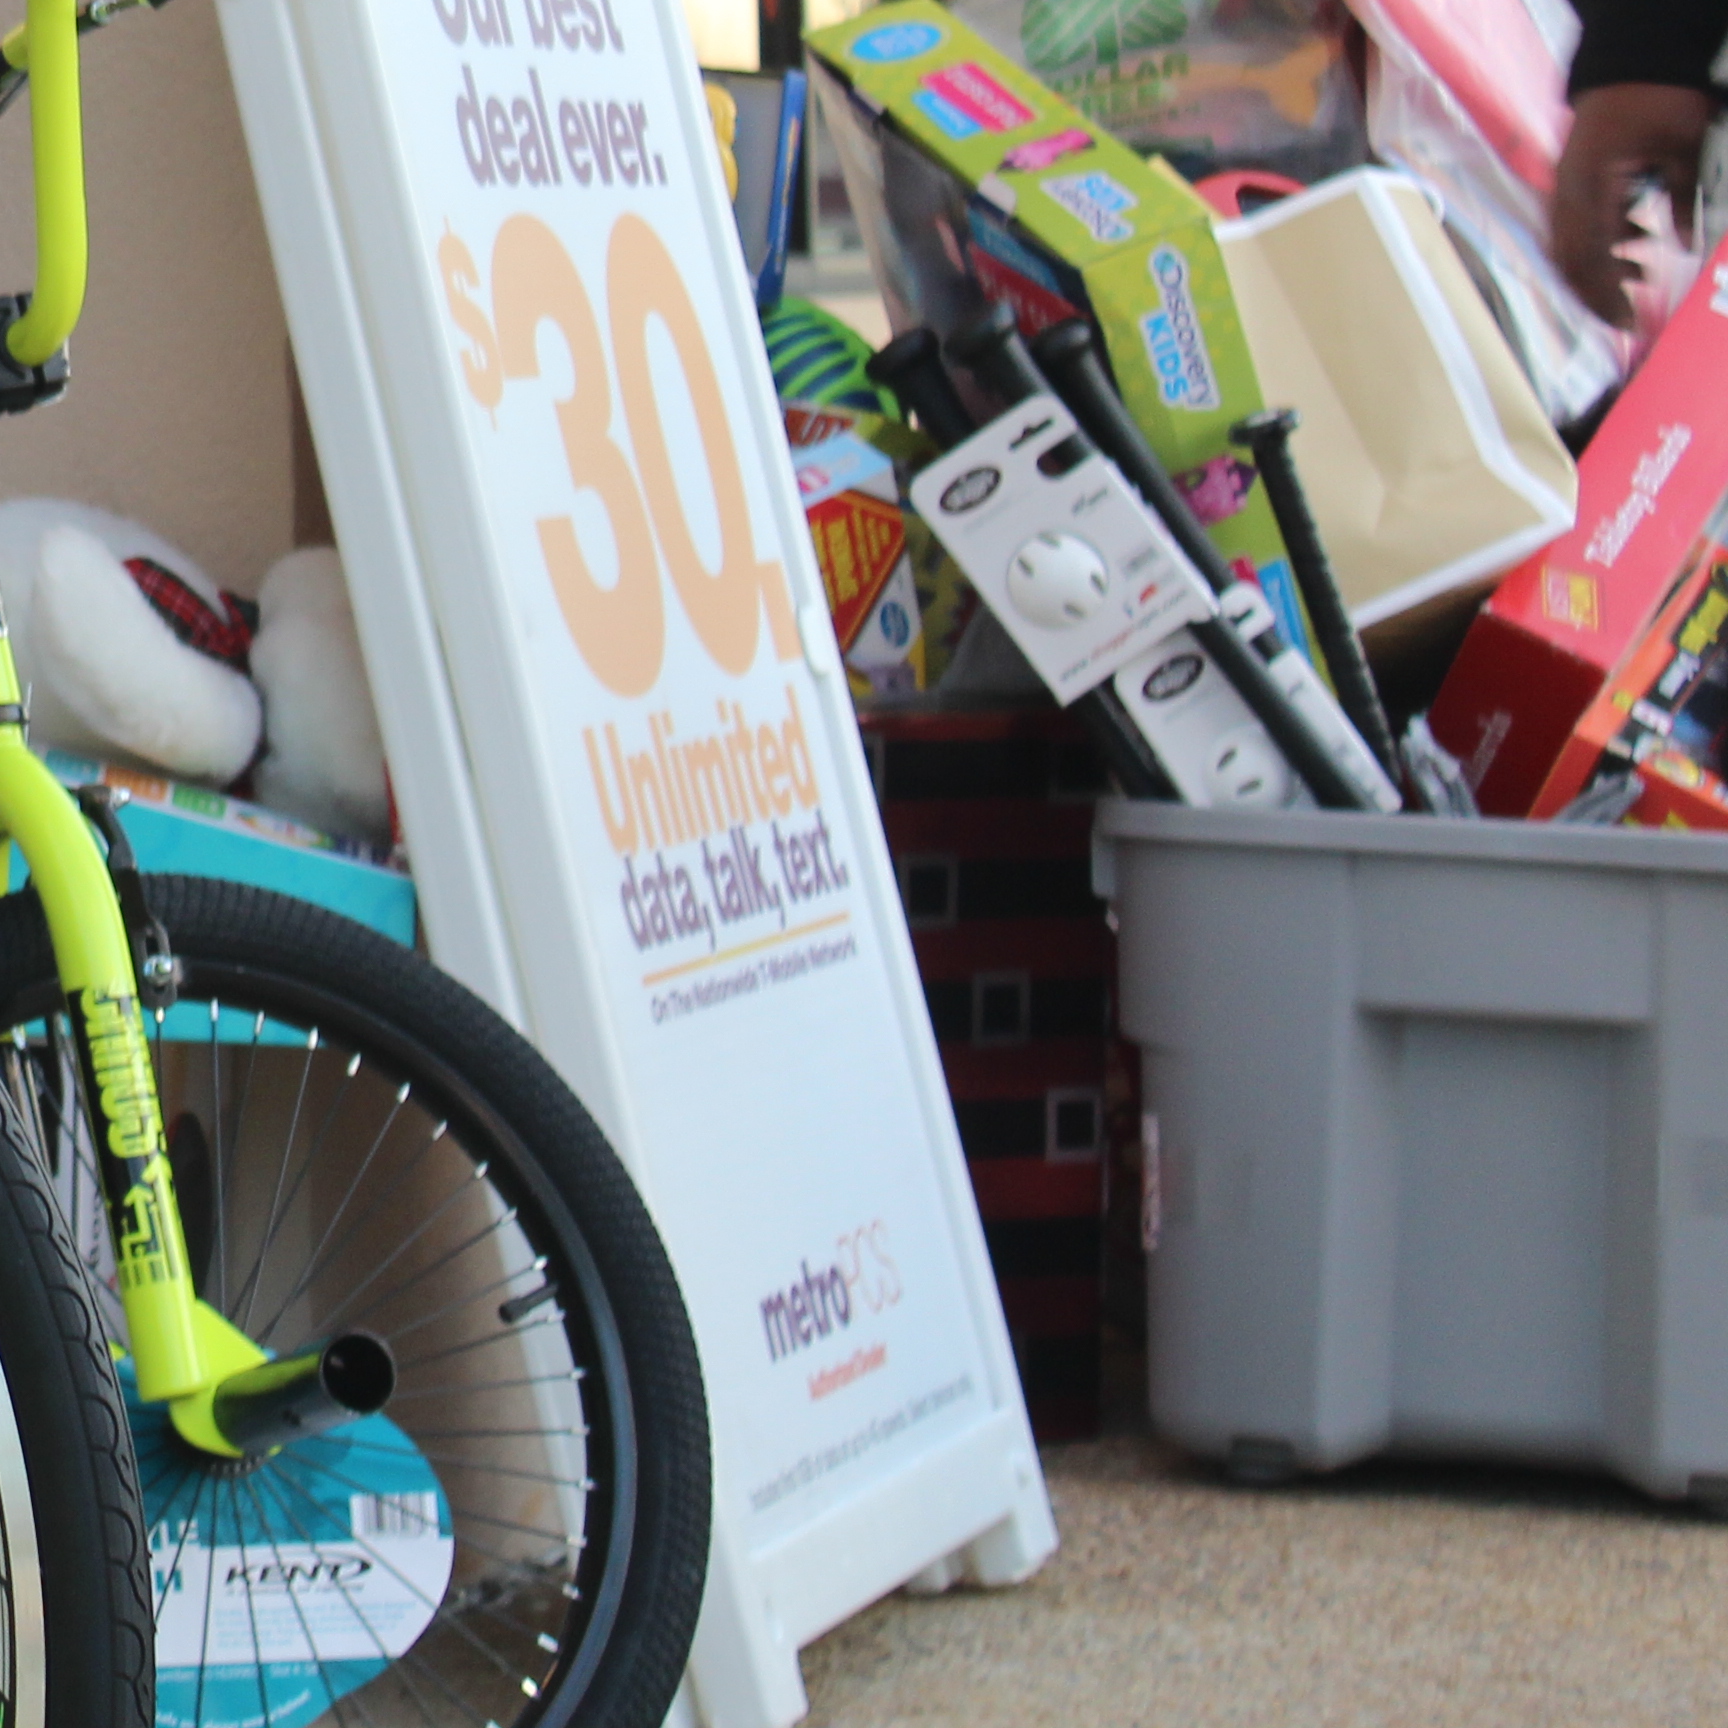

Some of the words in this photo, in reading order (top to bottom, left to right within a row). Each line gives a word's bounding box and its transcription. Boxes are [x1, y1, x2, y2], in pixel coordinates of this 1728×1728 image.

[455, 63, 564, 189] deal
[558, 87, 669, 189] ever.
[1144, 312, 1190, 402] KIDS
[1156, 256, 1213, 407] Discovery
[581, 683, 821, 860] Unlimited
[619, 850, 717, 953] data,
[702, 821, 788, 929] talk,
[772, 809, 851, 900] text.
